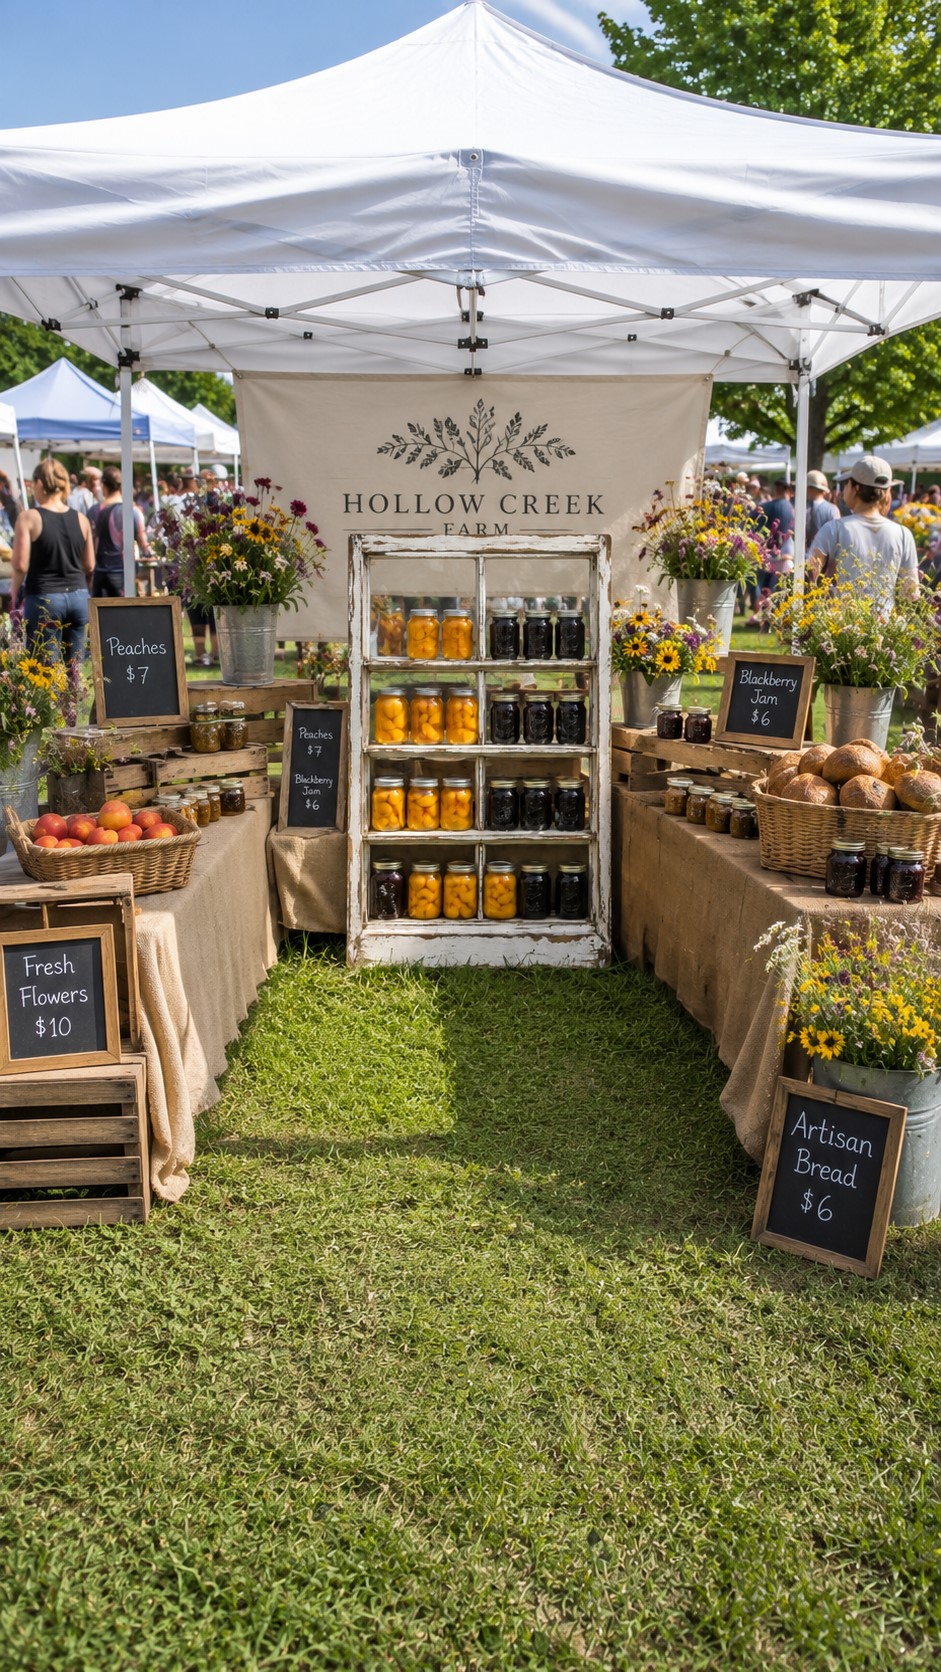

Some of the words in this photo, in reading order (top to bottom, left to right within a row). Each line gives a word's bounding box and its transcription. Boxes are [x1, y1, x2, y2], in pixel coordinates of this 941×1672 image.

[343, 493, 486, 515] HOLLOW
[499, 493, 605, 515] CREEK
[443, 522, 510, 536] FARM
[106, 637, 167, 656] Peaches
[126, 665, 149, 685] $7
[739, 669, 798, 692] Blackberry
[750, 688, 778, 705] Jam
[751, 708, 770, 726] $6
[298, 726, 334, 740] Peaches
[307, 745, 322, 757] $7
[295, 773, 333, 788] Blackberry
[302, 786, 321, 796] Jam
[305, 798, 320, 811] $6
[22, 953, 76, 977] Fresh
[18, 985, 89, 1008] Flowers
[35, 1015, 72, 1038] $10
[790, 1110, 873, 1158] Artisan
[793, 1147, 858, 1189] Bread
[800, 1188, 833, 1222] $6
